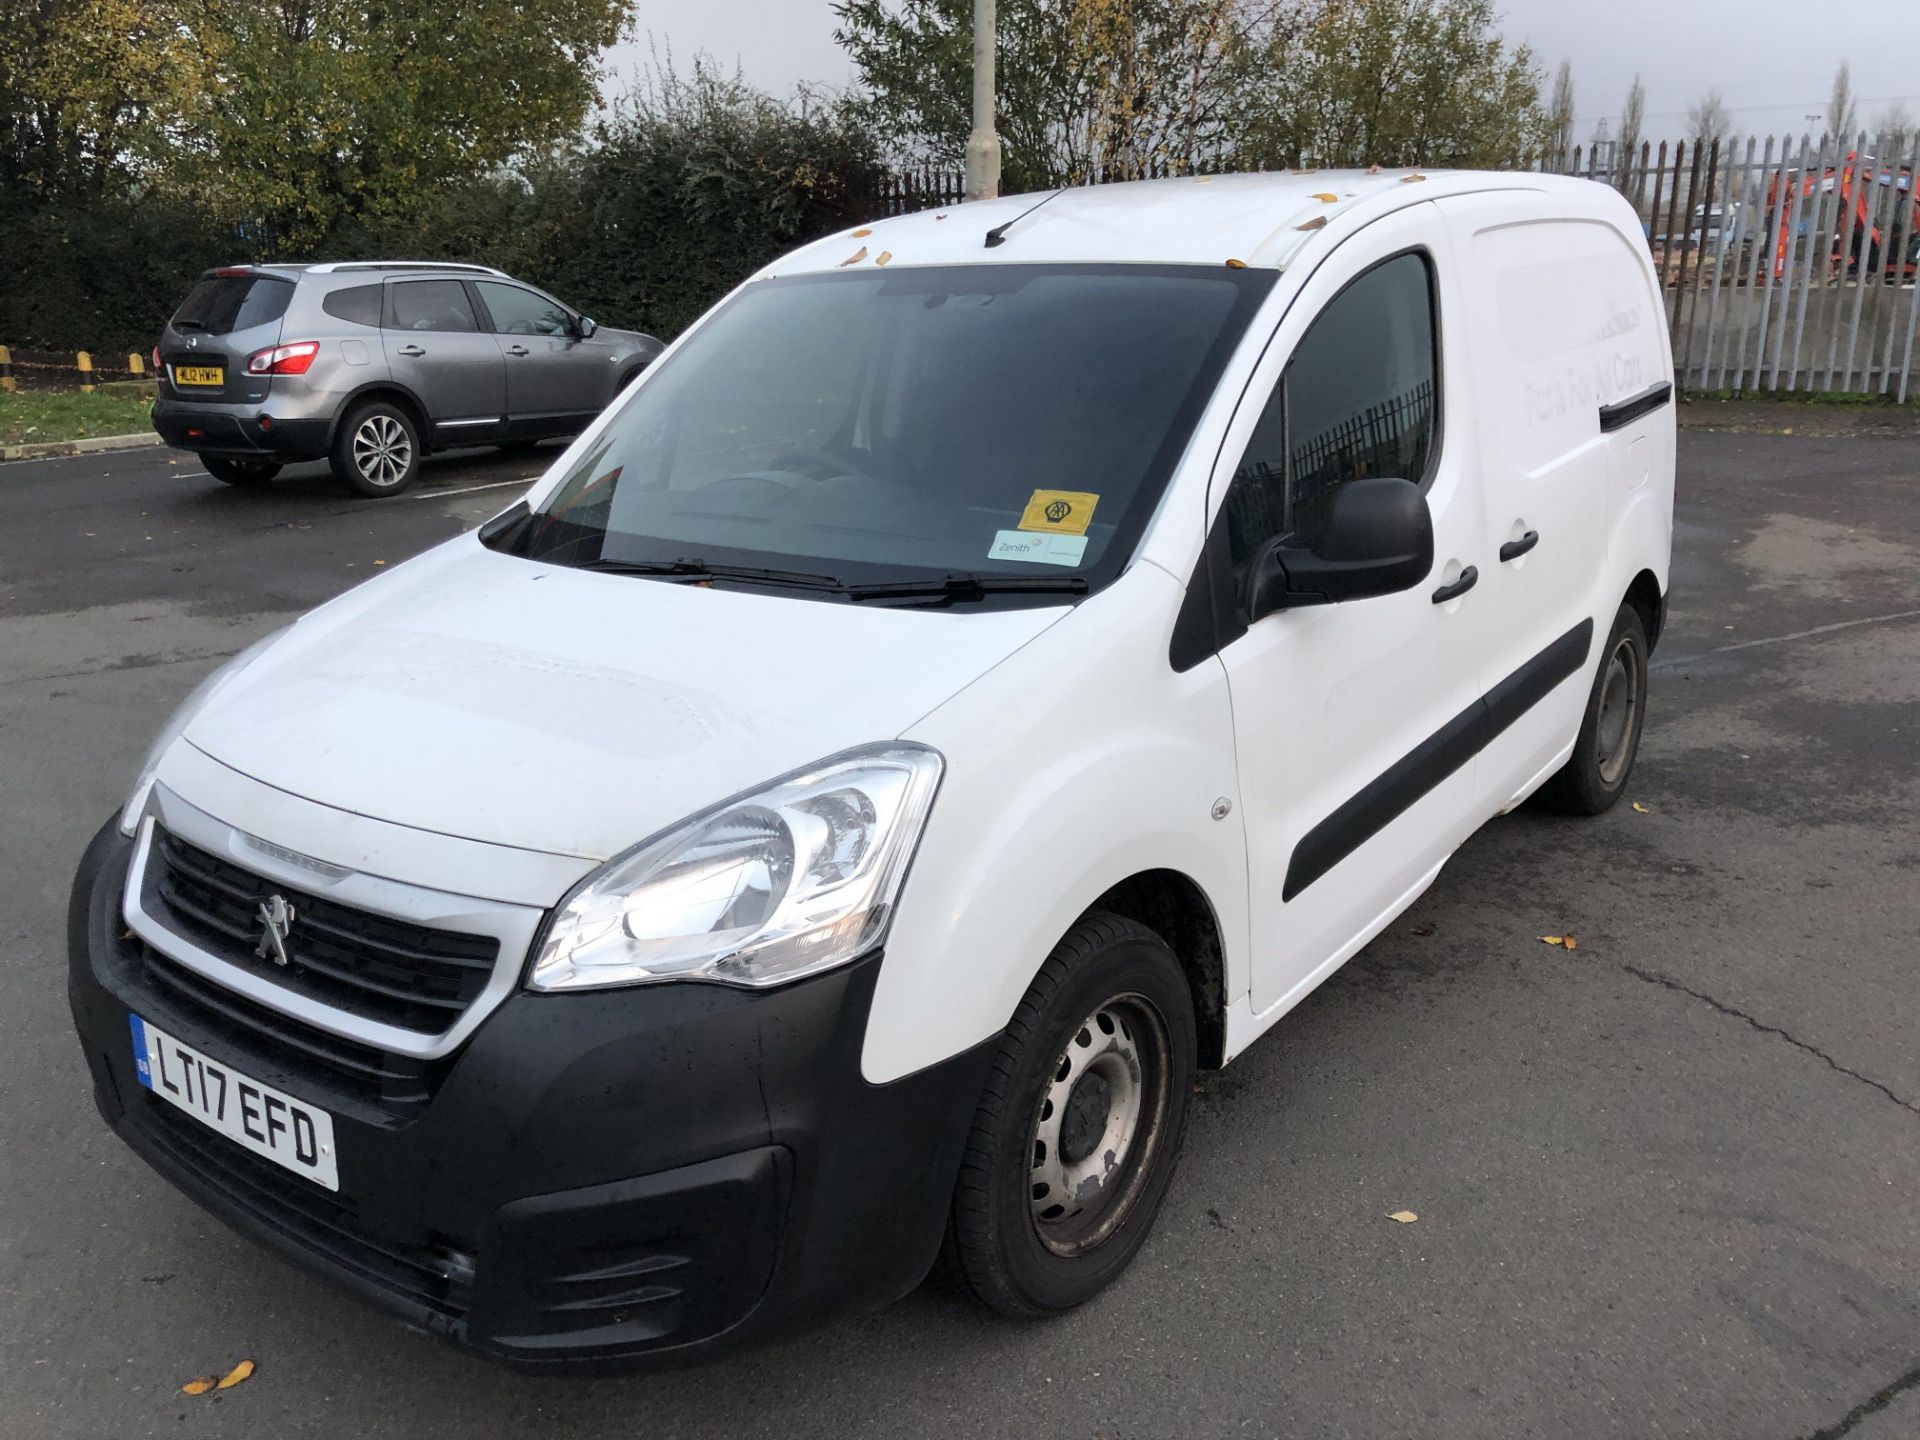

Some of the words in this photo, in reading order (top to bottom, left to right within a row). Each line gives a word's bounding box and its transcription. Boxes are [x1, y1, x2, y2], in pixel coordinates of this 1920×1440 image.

[999, 542, 1030, 553] Zenith
[156, 1037, 227, 1122] LT17
[238, 1081, 318, 1168] EFD
